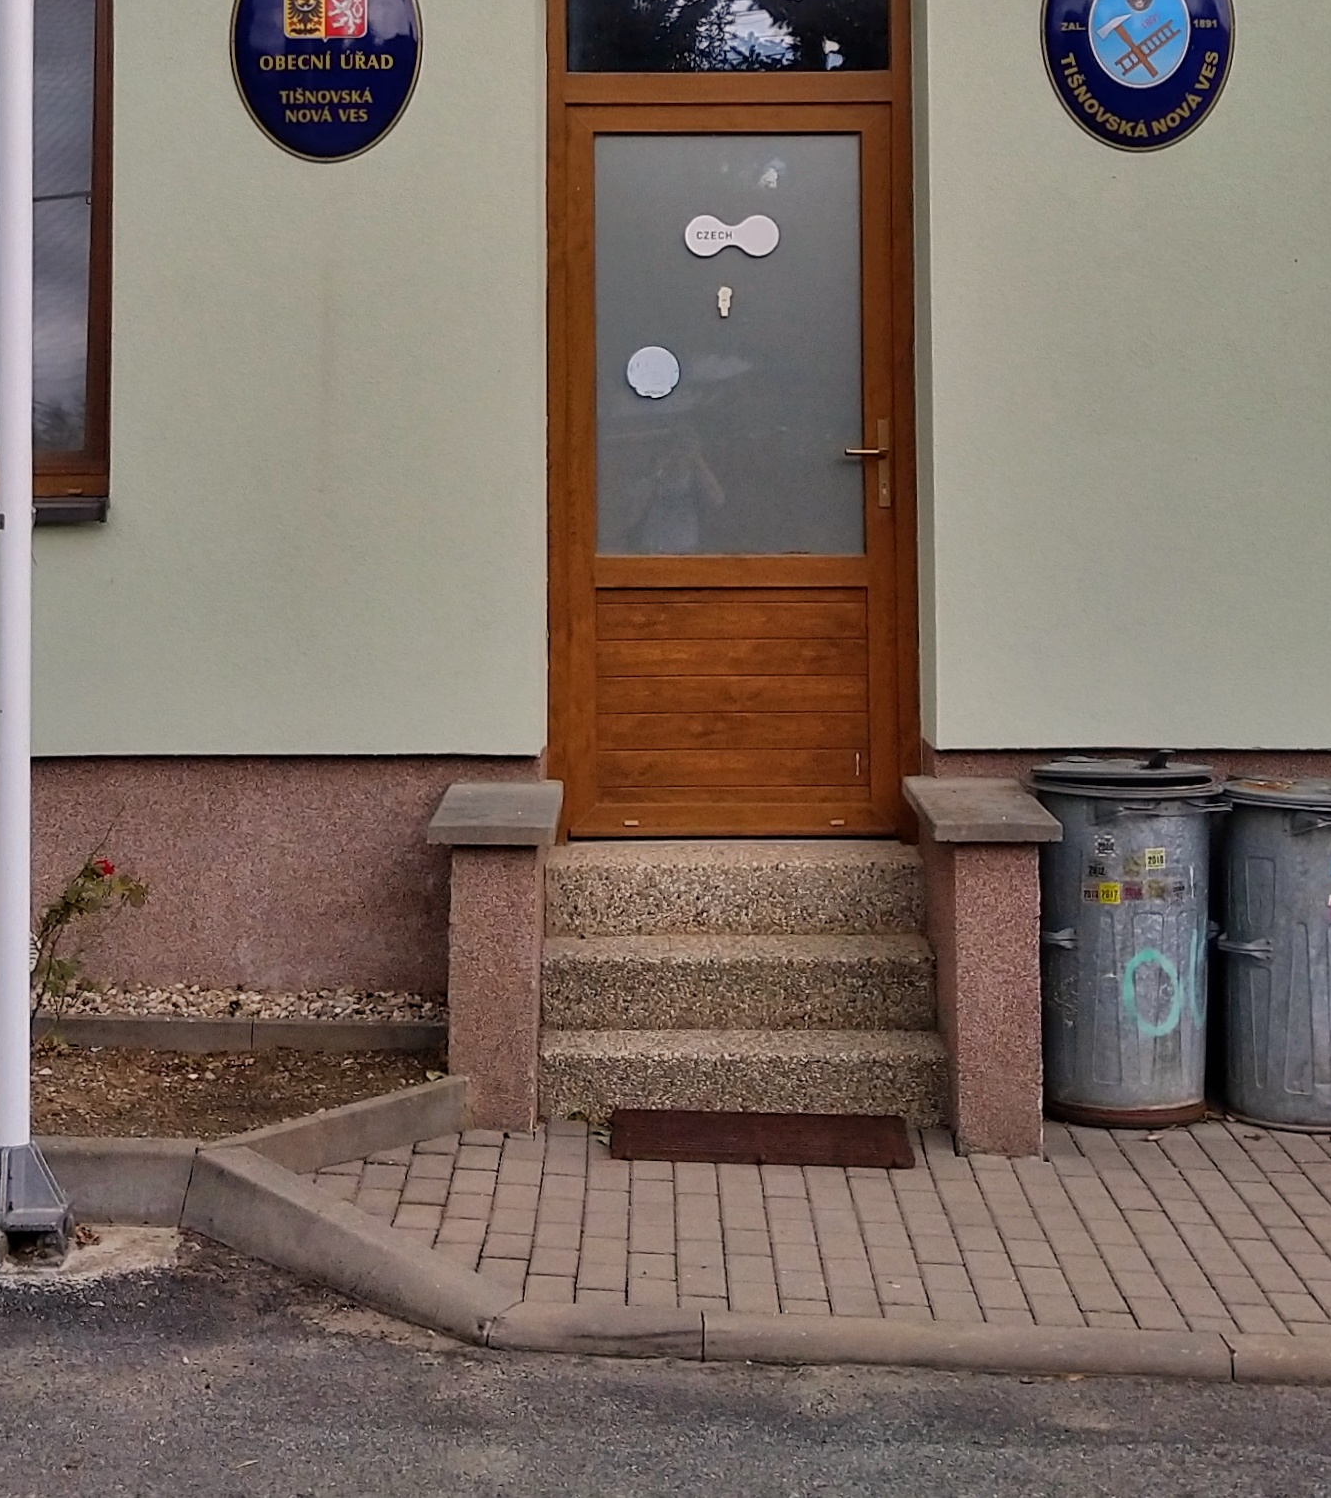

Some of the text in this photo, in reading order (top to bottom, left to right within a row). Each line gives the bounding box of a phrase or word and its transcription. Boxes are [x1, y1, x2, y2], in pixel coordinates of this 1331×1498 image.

[1193, 19, 1218, 28] 1891
[259, 50, 395, 71] OBECNÍ ÚŘAD
[279, 87, 374, 105] TIŠNOVSKÁ
[1061, 51, 1219, 138] TIŠNOVSKÁ NOVÁ VES
[285, 106, 368, 123] NOVÁ VES
[695, 230, 734, 240] CZECH
